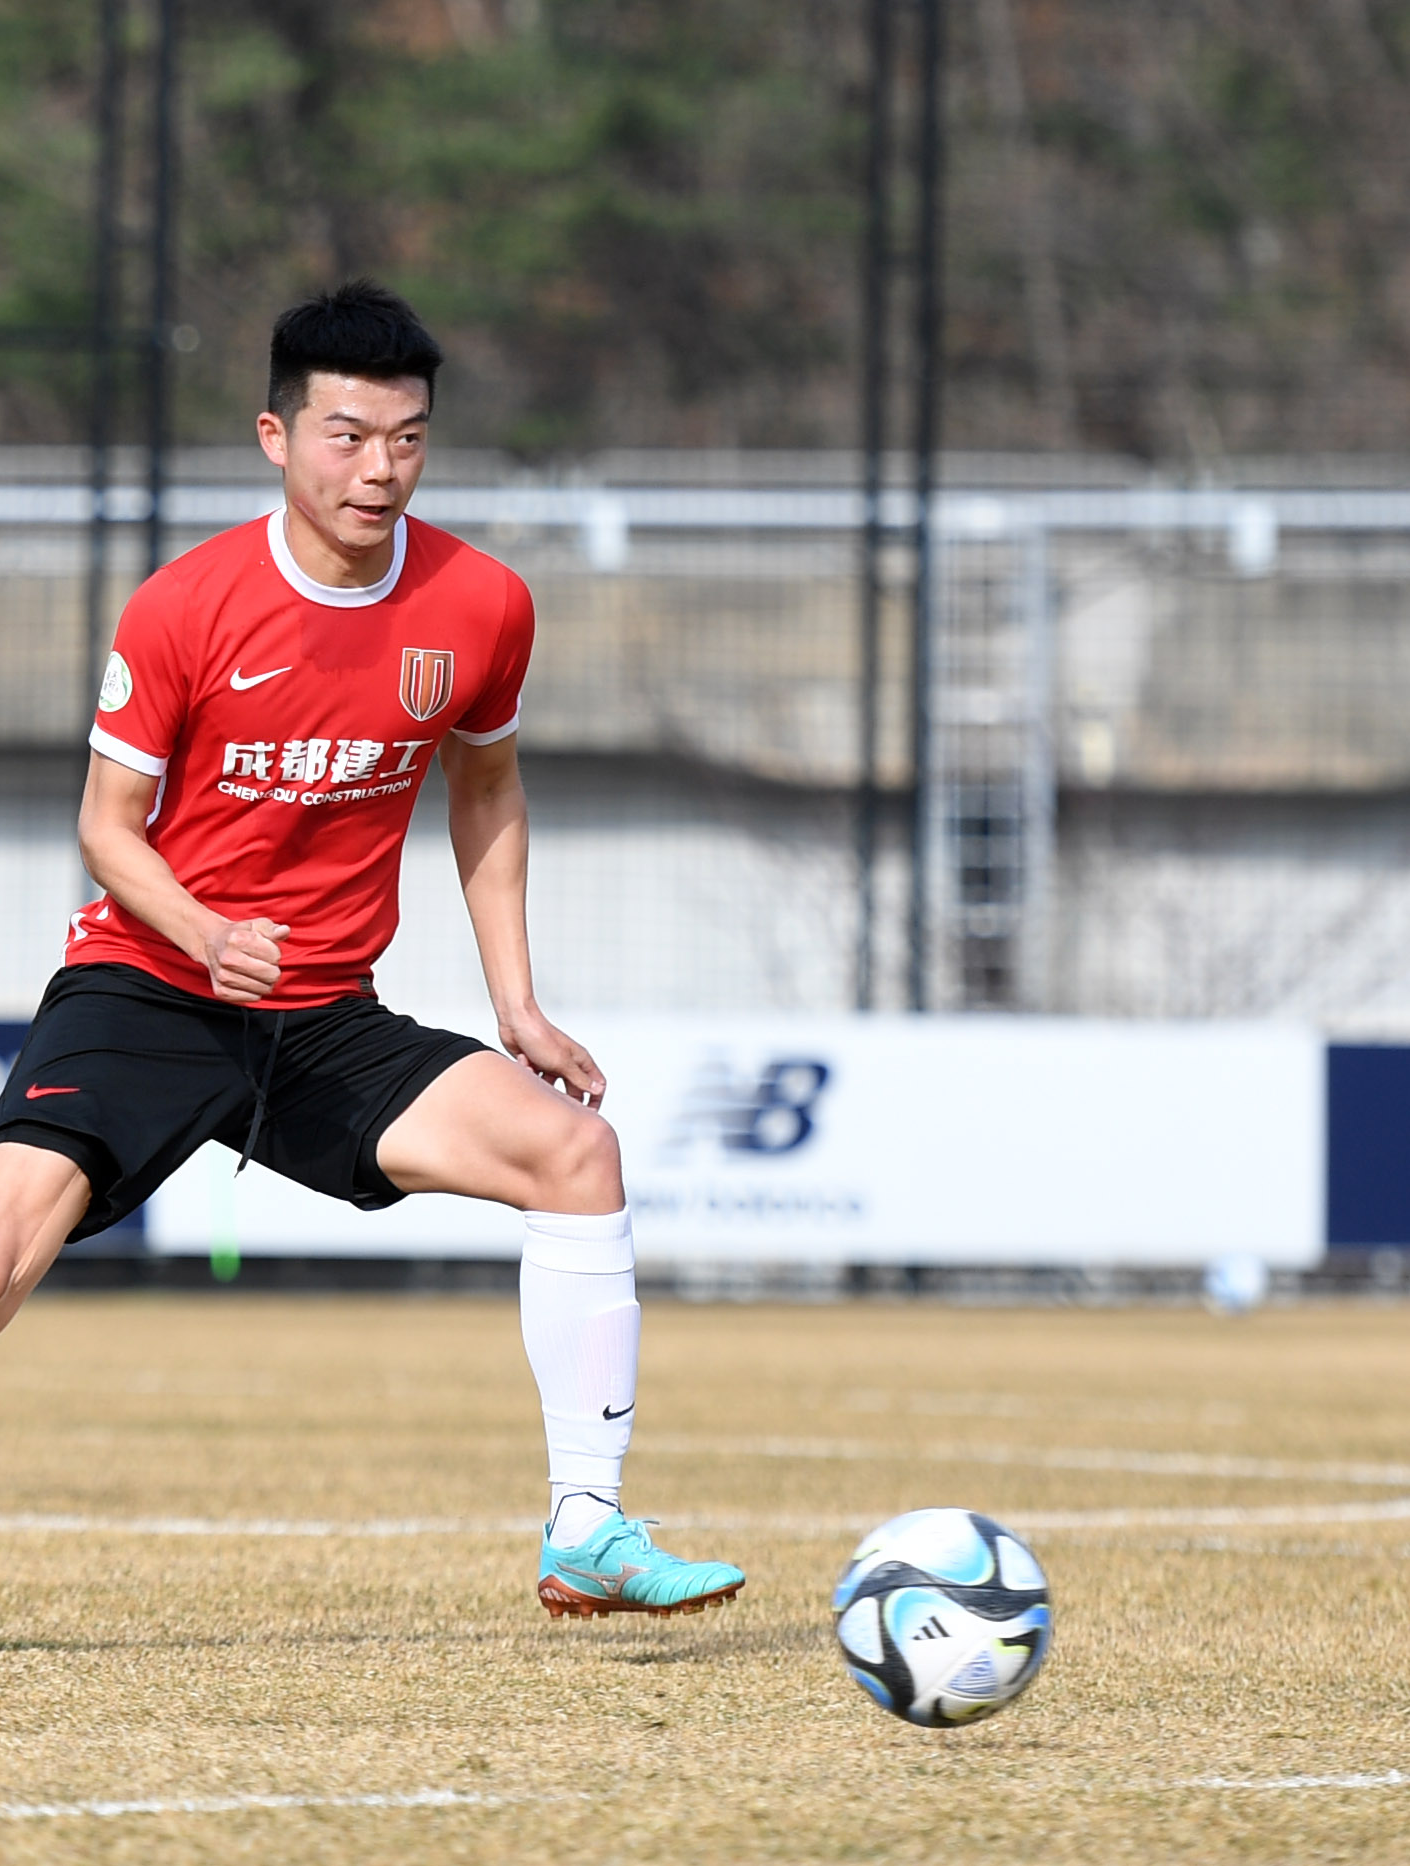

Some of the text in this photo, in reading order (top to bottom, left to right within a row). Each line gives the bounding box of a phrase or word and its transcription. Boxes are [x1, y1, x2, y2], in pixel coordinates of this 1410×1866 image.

[222, 738, 434, 784] 成都建工
[217, 777, 413, 806] CHENGDU CONSTRUCTION
